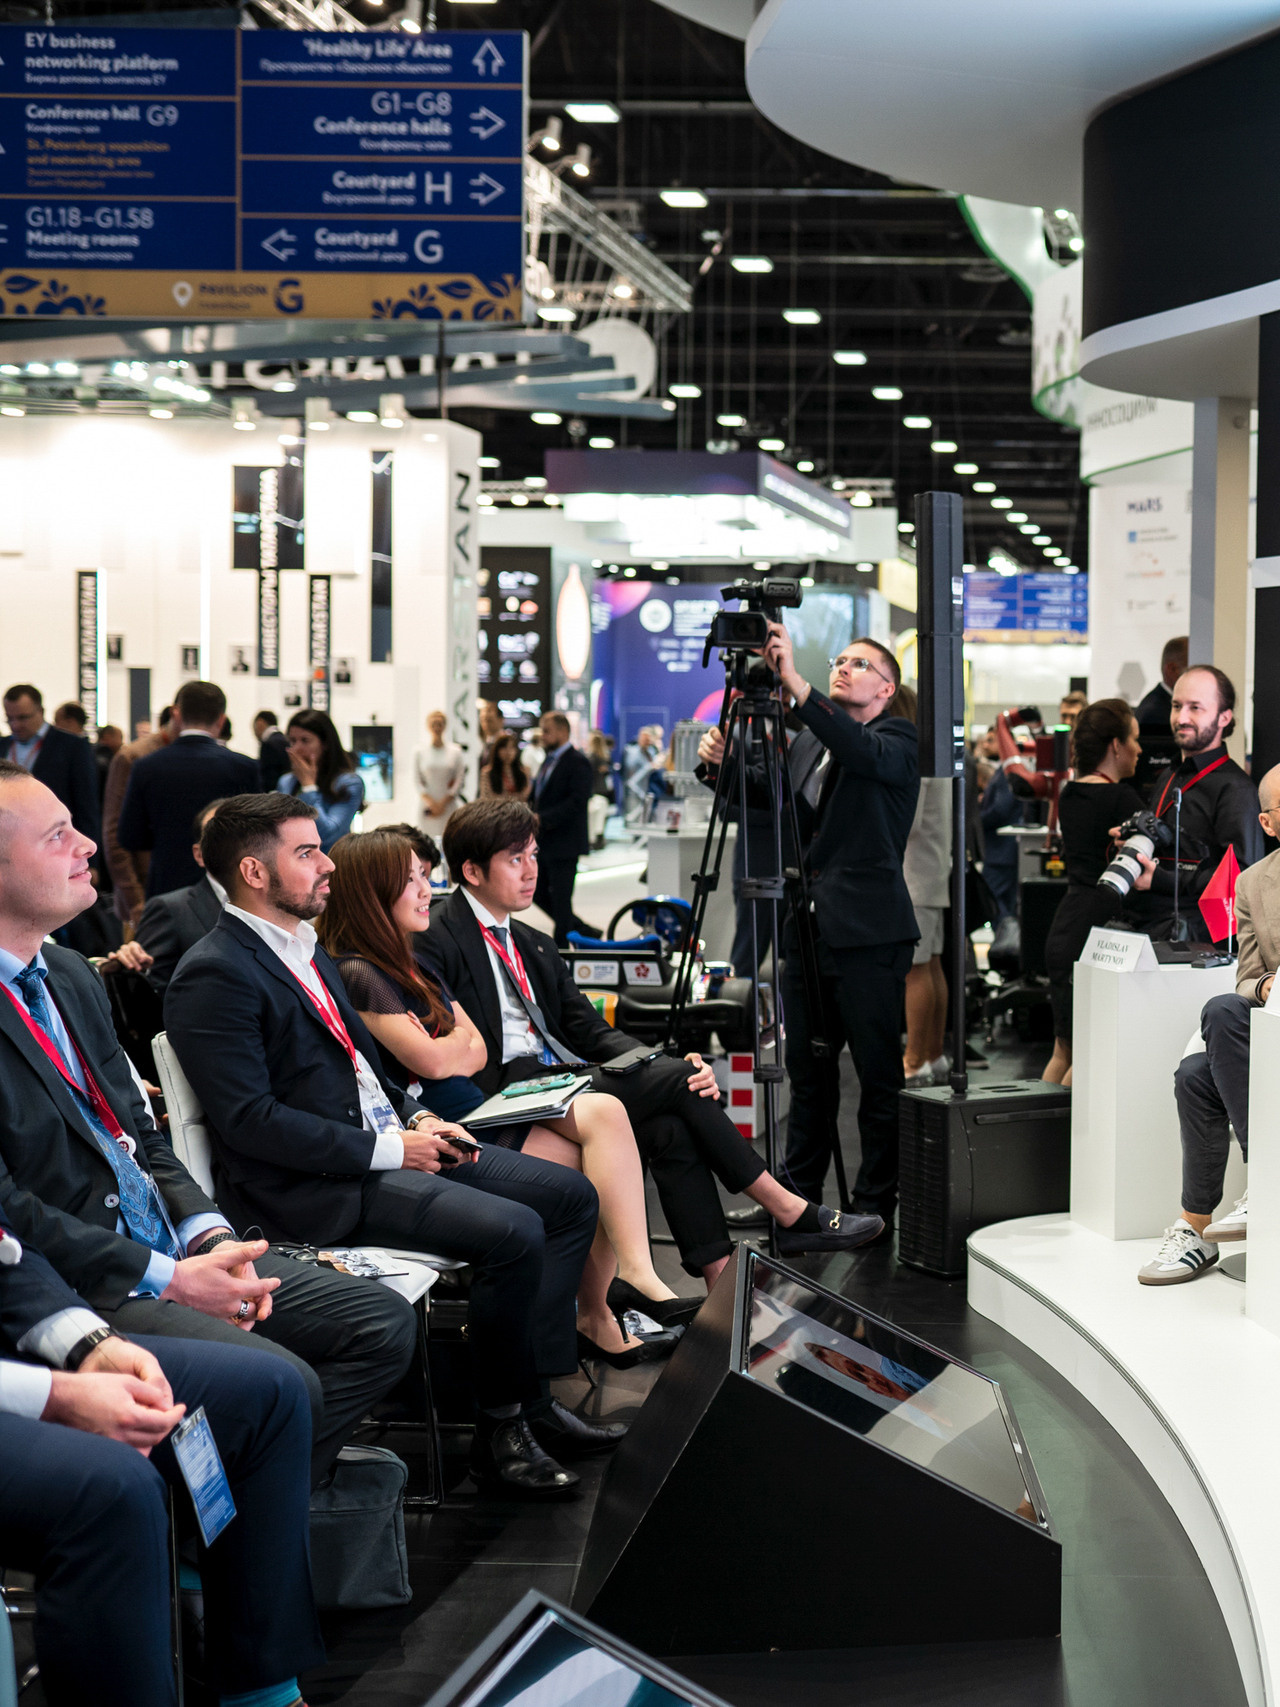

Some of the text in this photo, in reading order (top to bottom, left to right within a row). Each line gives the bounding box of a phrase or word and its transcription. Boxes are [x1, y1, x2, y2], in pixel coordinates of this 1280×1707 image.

[25, 32, 116, 49] EY business
[413, 40, 453, 58] Area
[25, 53, 179, 73] networking platform
[25, 103, 179, 127] Conference hall G9
[313, 116, 453, 136] Conference halls
[332, 171, 453, 205] Courtyard H
[26, 230, 140, 249] Meeting rooms
[315, 227, 444, 264] Courtyard G
[274, 279, 304, 314] G
[1097, 939, 1129, 953] VLADISLAV
[1091, 952, 1124, 966] MARTYNOV
